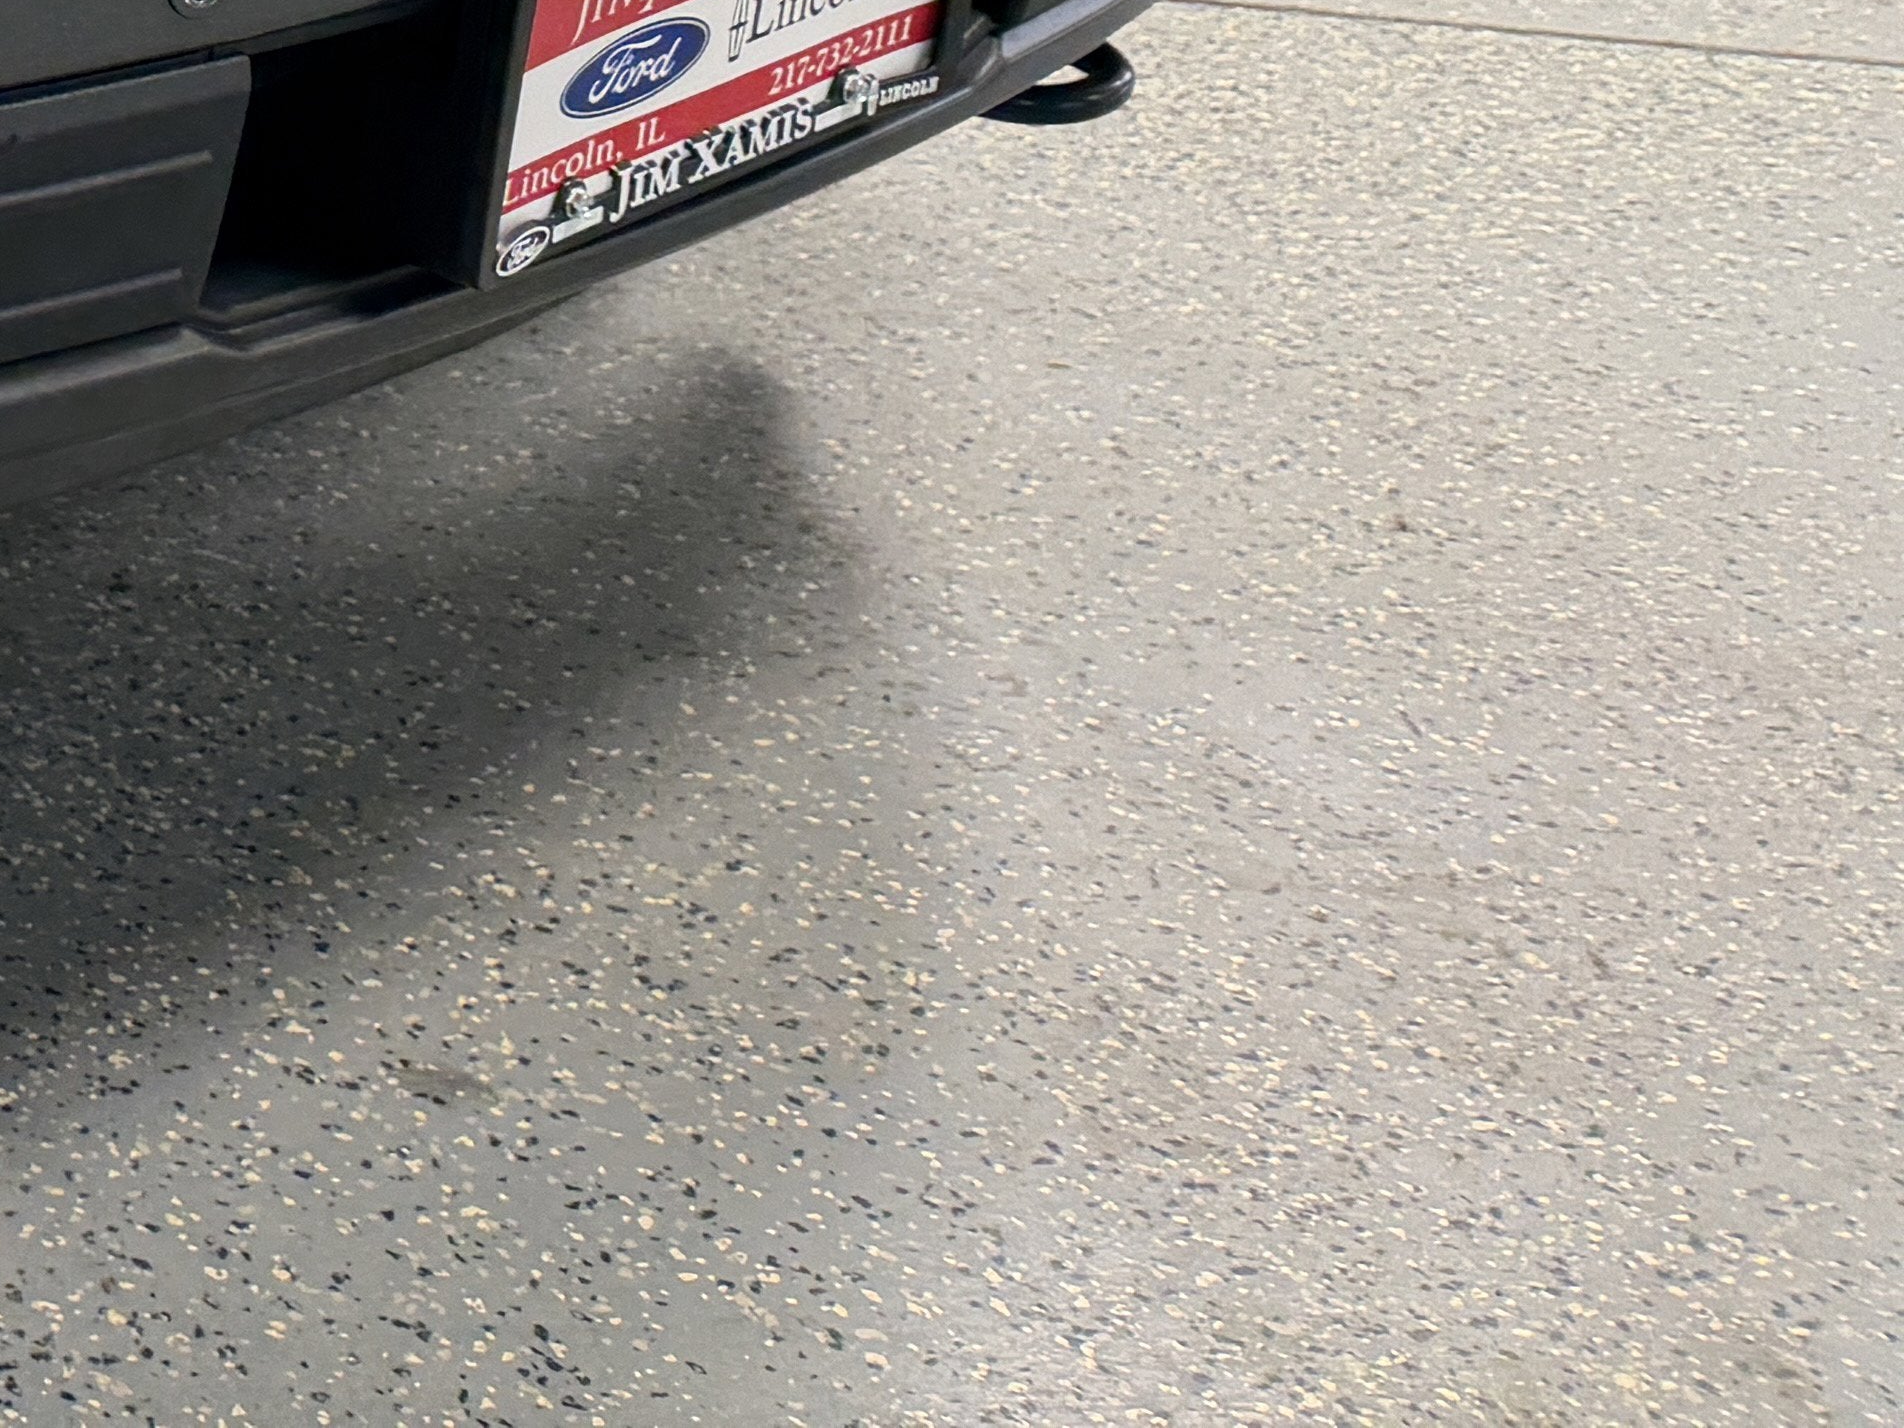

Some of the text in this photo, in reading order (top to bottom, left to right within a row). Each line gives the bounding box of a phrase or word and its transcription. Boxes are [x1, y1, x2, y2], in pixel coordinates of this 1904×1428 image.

[588, 33, 683, 105] Ford
[767, 13, 914, 96] 217-732-2111
[502, 116, 666, 207] Lincoln, IL
[609, 100, 813, 224] JIM XAMIS
